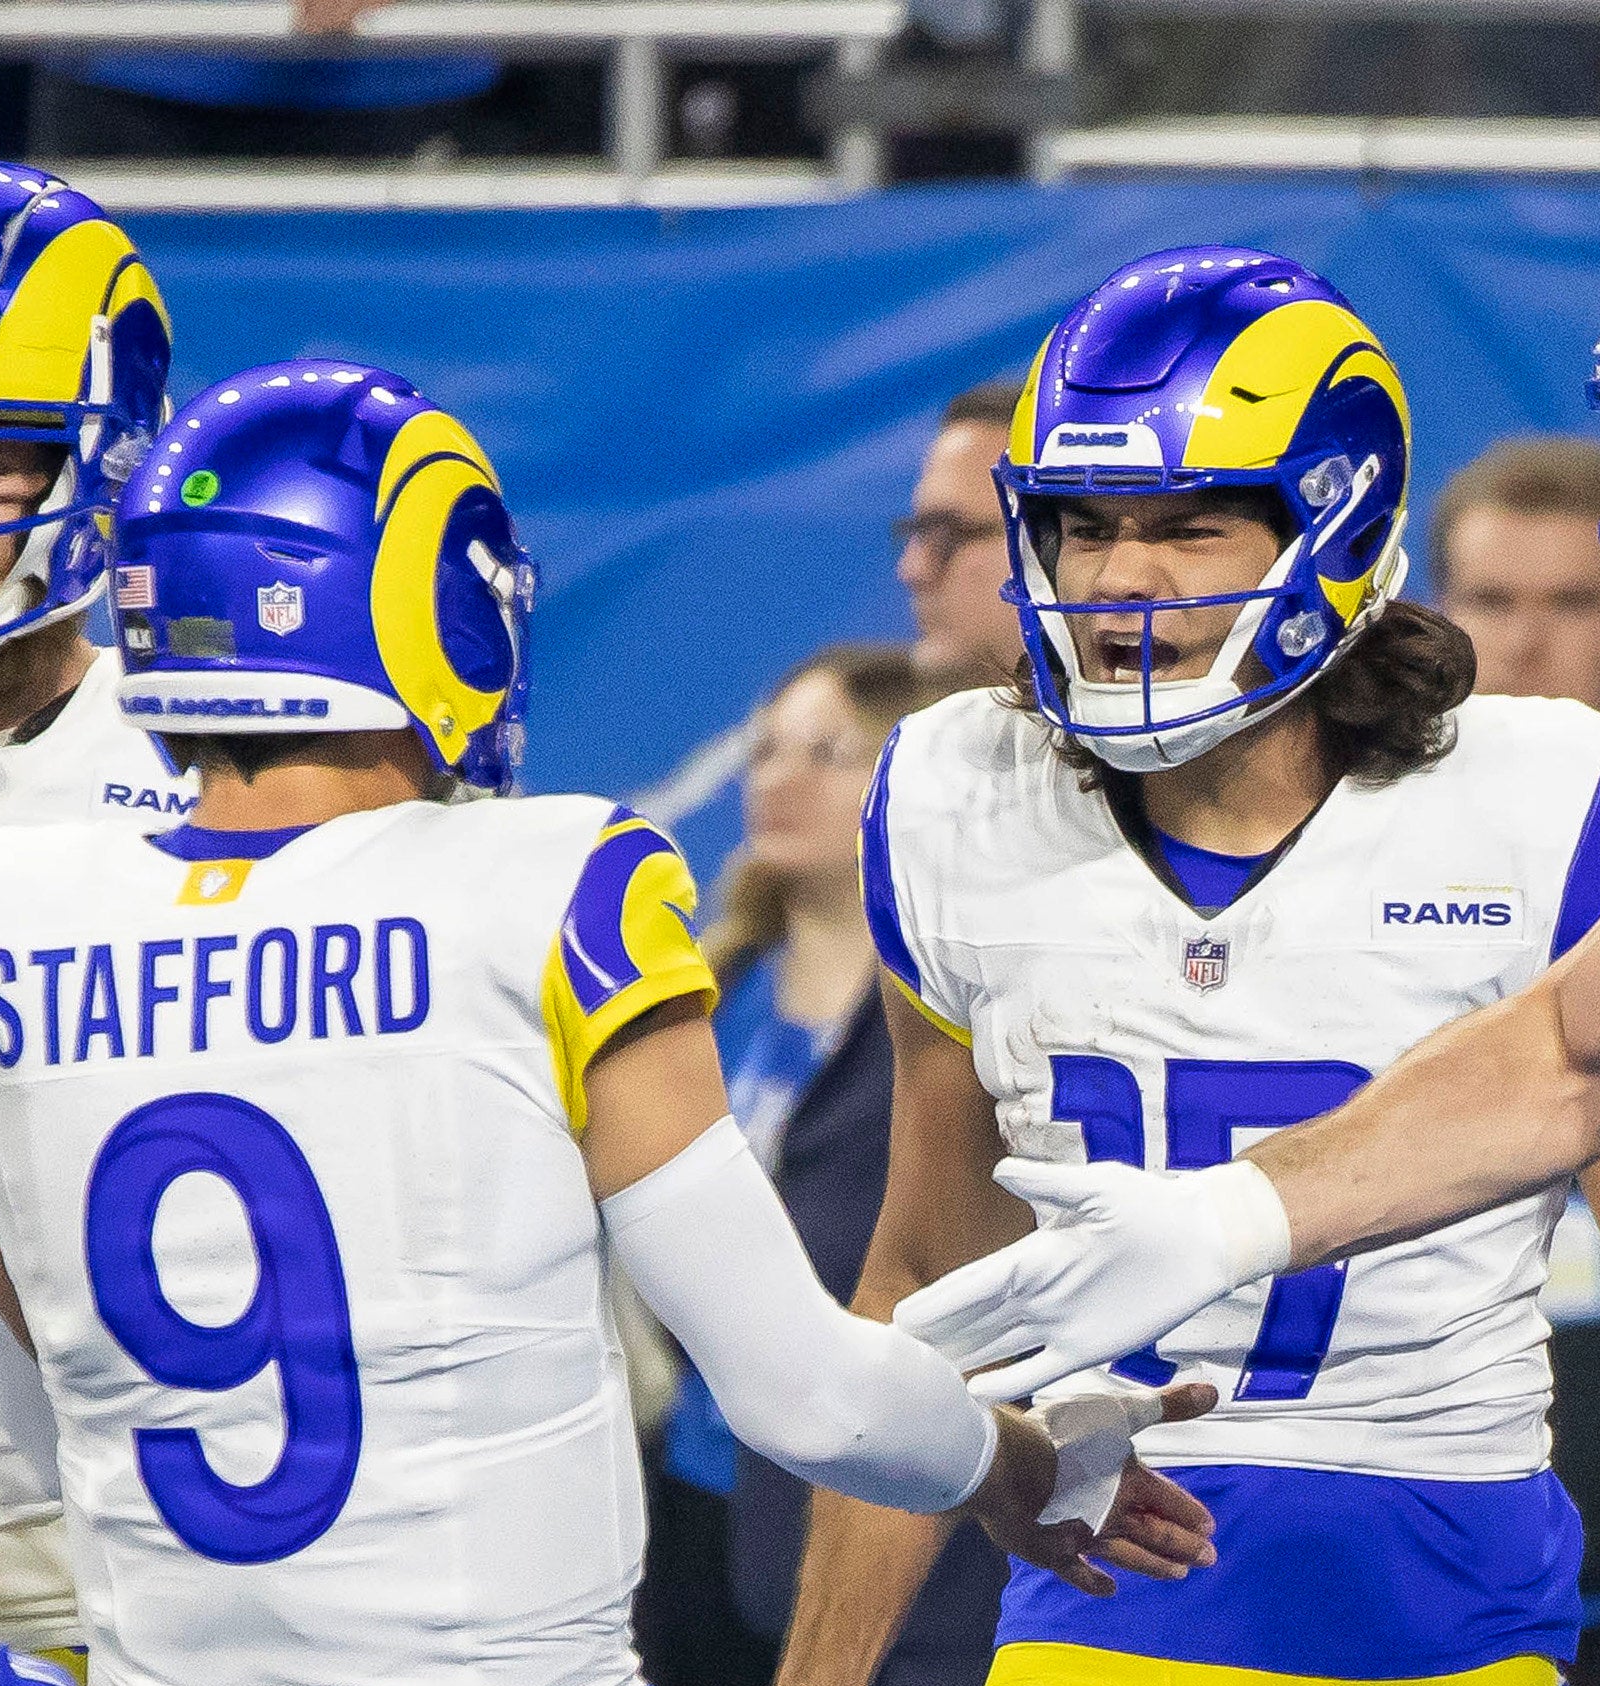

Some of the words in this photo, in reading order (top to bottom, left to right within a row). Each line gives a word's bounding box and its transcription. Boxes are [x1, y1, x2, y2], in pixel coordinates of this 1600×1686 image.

[103, 783, 201, 815] RAM
[1383, 902, 1511, 926] RAMS
[82, 1092, 362, 1566] 9
